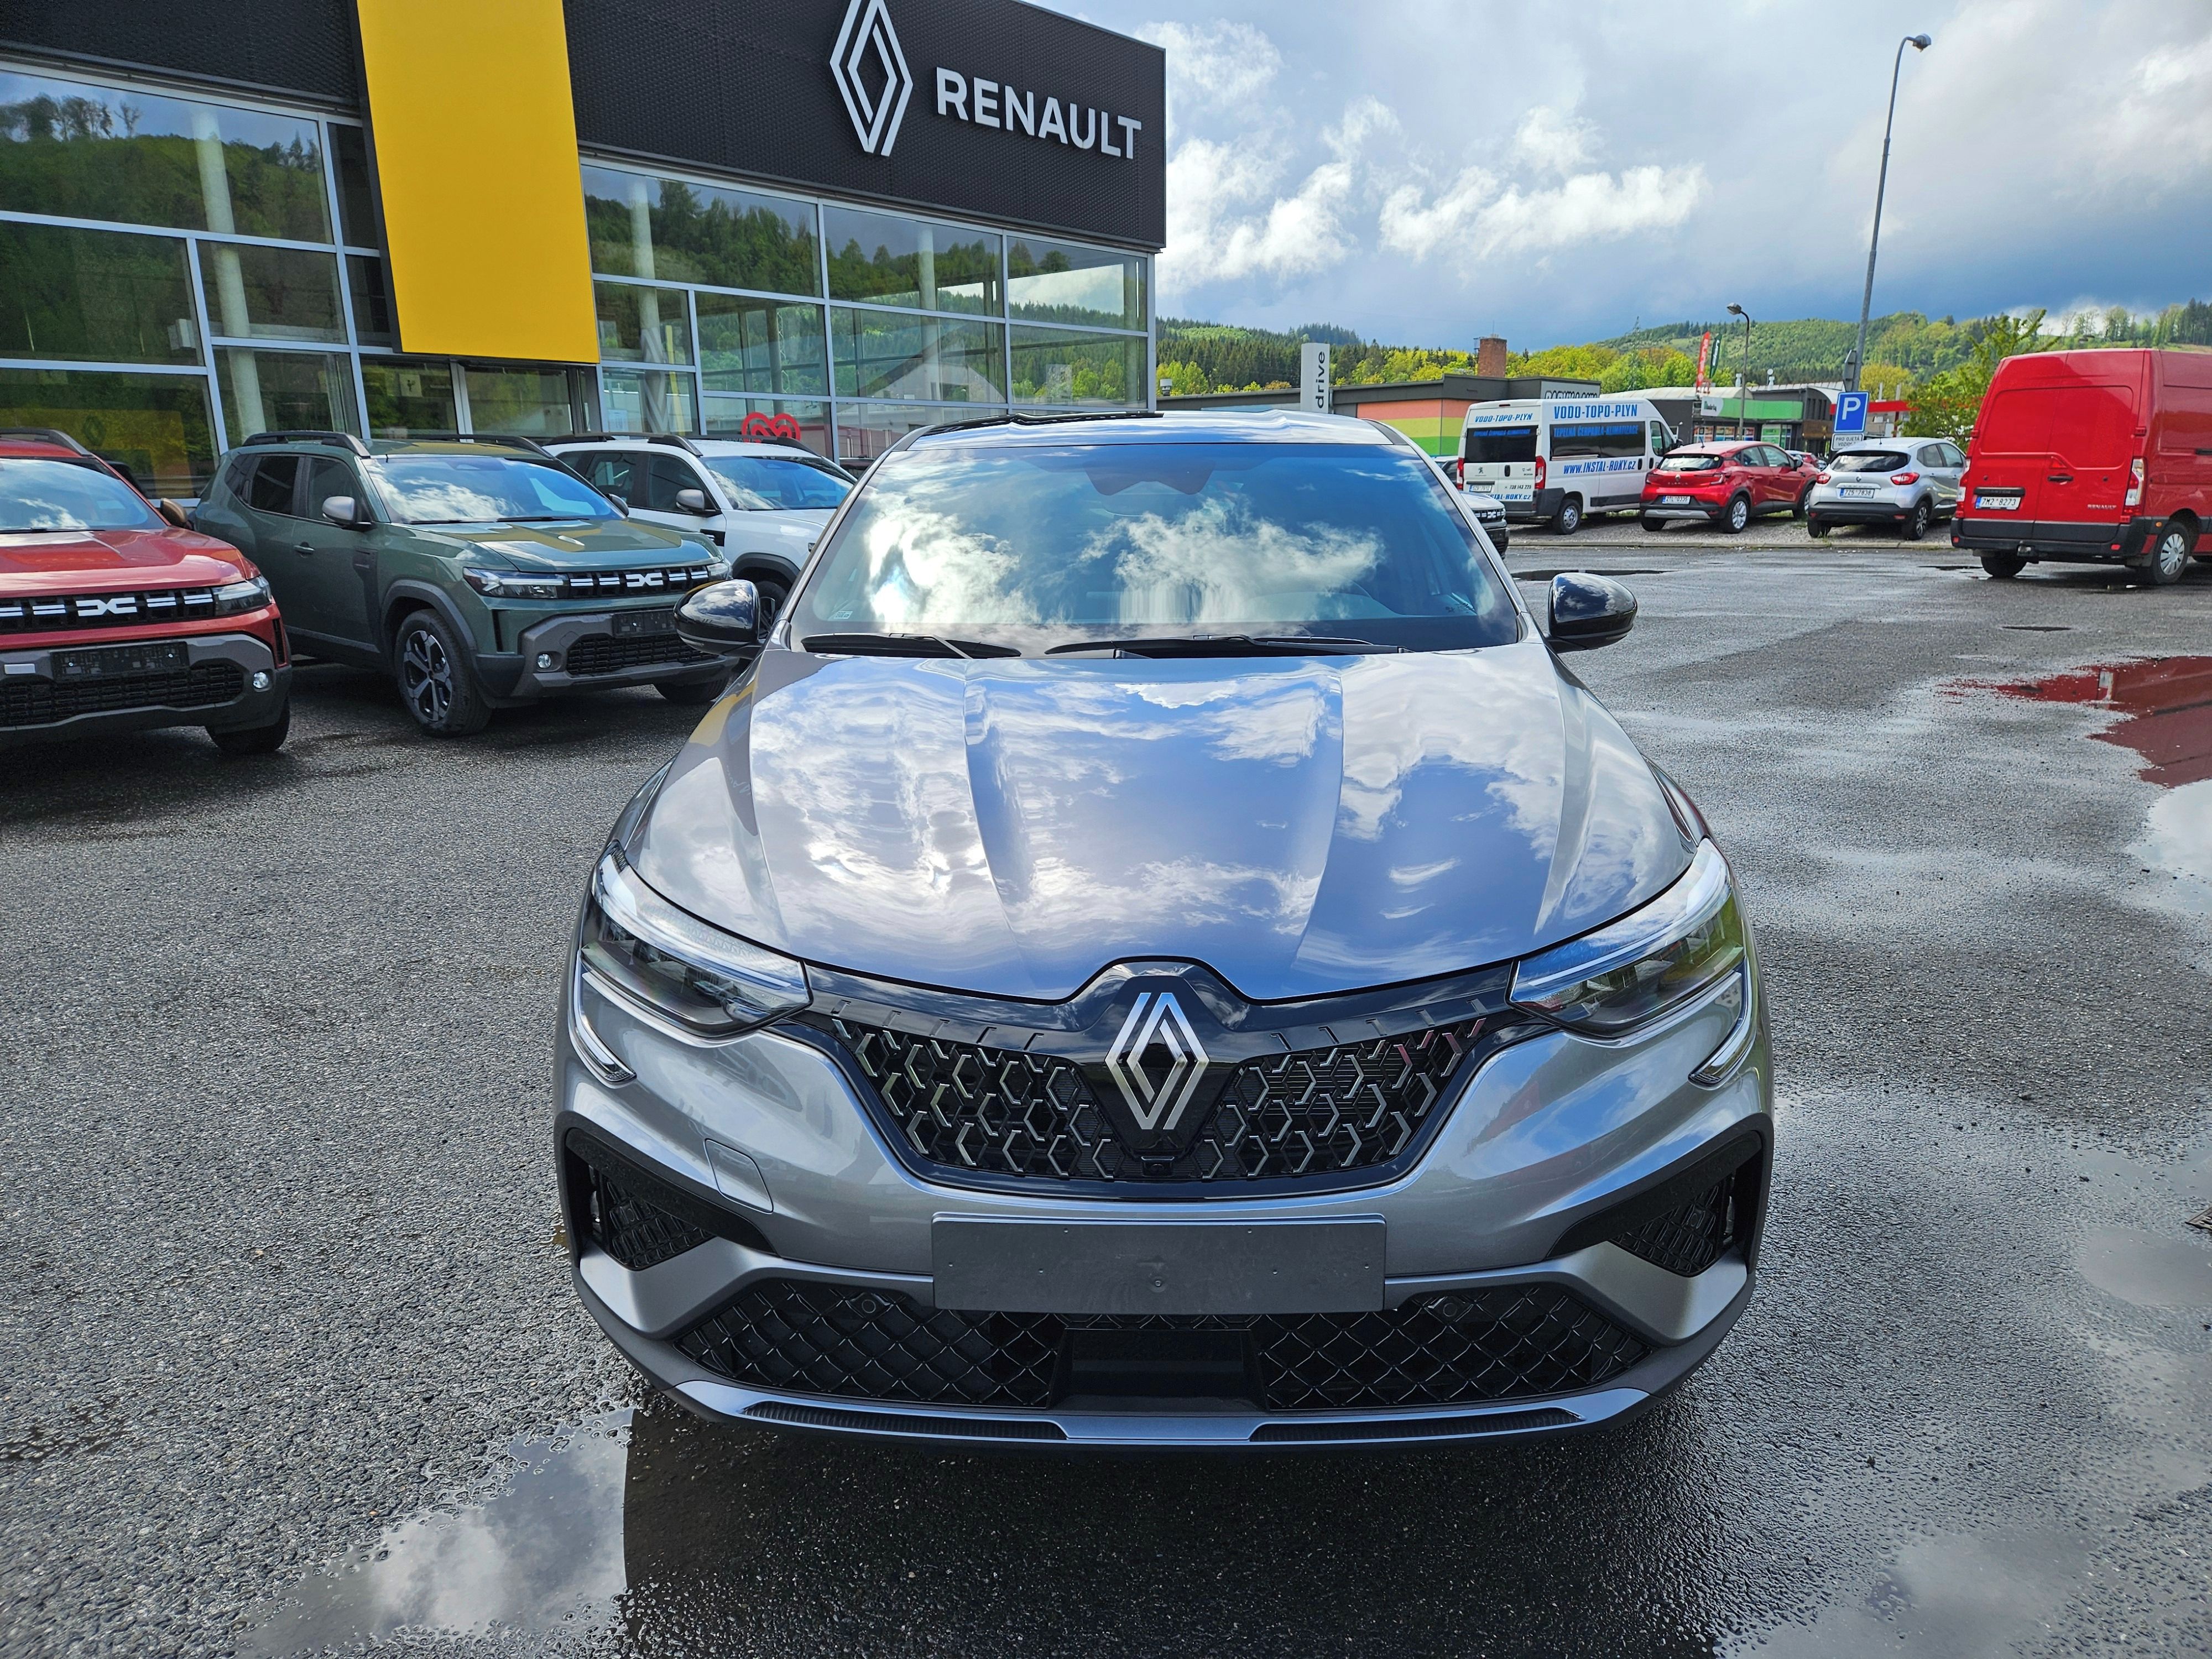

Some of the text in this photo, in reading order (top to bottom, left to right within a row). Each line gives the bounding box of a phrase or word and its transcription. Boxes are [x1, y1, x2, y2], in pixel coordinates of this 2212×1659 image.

[937, 67, 1141, 159] RENAULT
[1316, 351, 1325, 409] drive
[1475, 413, 1533, 422] VODO-TOPO-PLYN
[1554, 404, 1637, 419] VODO-TOPO-PLYN
[1842, 397, 1861, 420] P
